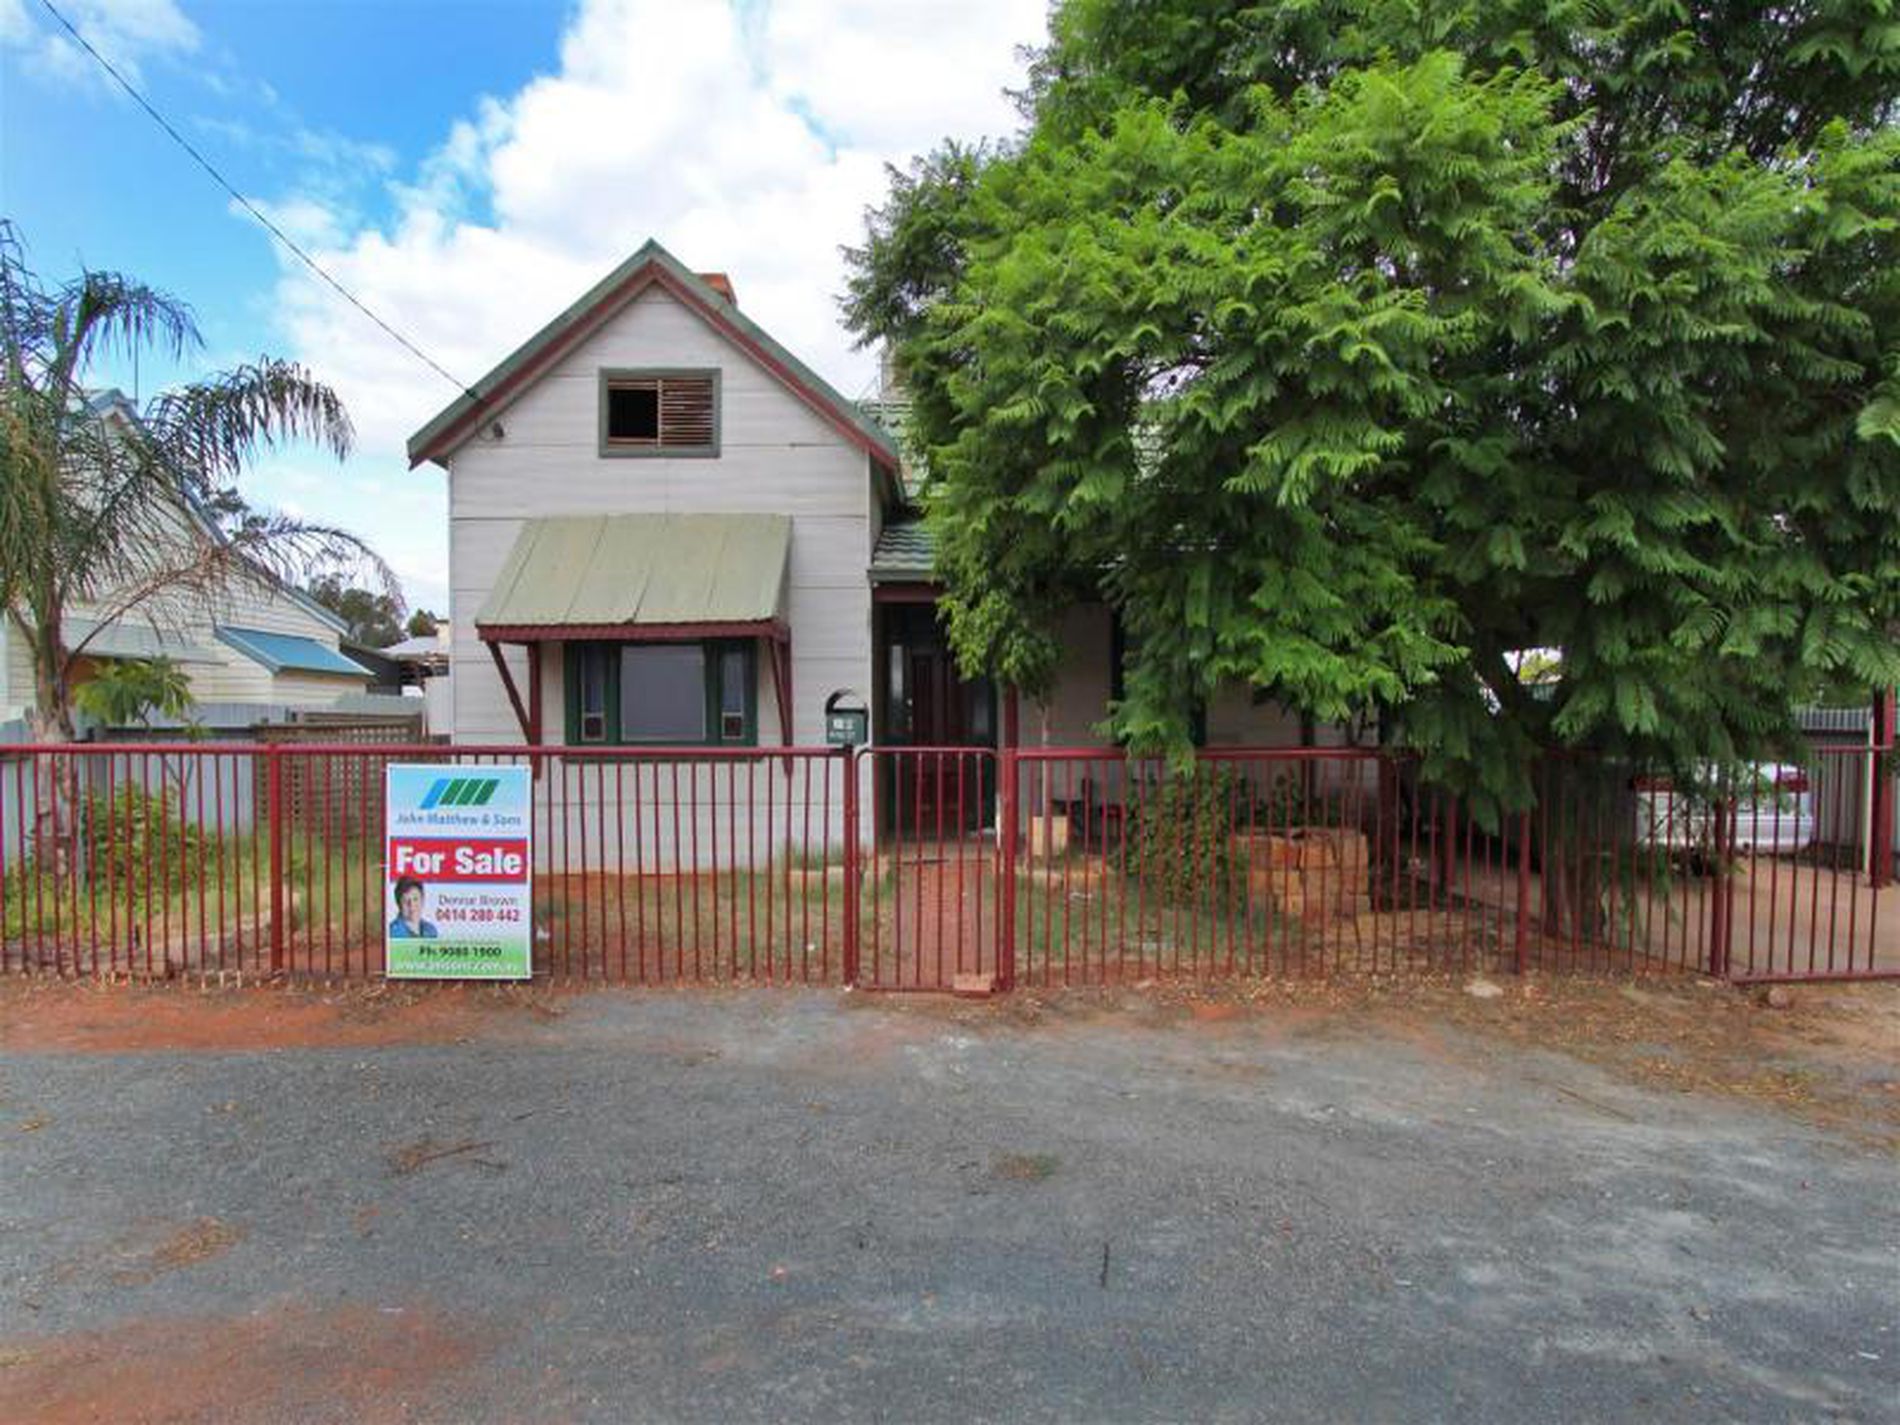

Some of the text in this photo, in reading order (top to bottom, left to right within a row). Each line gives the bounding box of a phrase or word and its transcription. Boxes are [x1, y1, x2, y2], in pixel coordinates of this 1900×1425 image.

[396, 813, 522, 826] John Matthew & Sons
[396, 846, 522, 876] For Sale
